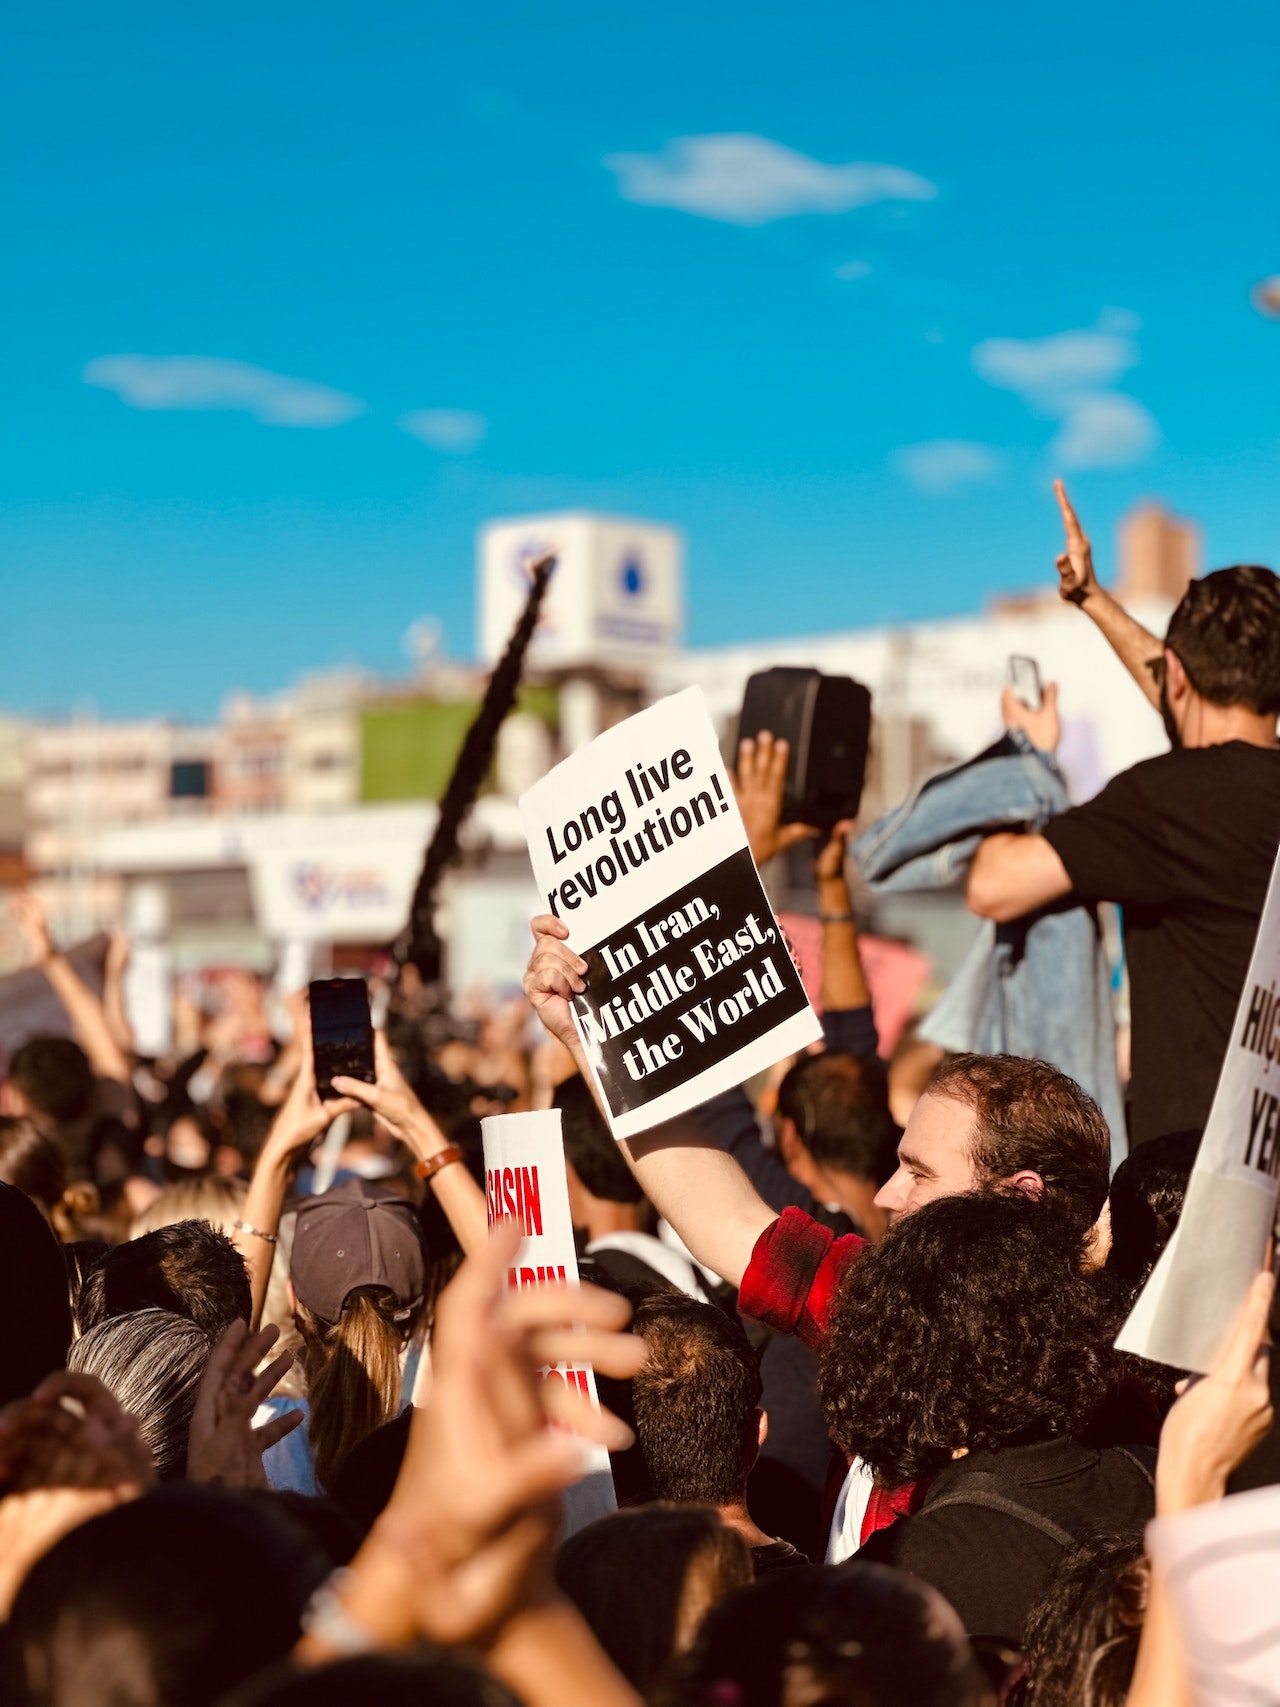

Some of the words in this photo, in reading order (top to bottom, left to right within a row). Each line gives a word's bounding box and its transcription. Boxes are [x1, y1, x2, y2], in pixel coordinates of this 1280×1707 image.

[545, 790, 626, 865] Long
[624, 747, 694, 809] live
[546, 773, 730, 919] revolution!
[578, 962, 697, 1043] Middle
[691, 913, 777, 982] East,
[598, 943, 644, 982] In
[634, 896, 721, 949] Iran,
[622, 1027, 684, 1082] the
[678, 956, 786, 1044] World
[1241, 979, 1280, 1075] HİÇ
